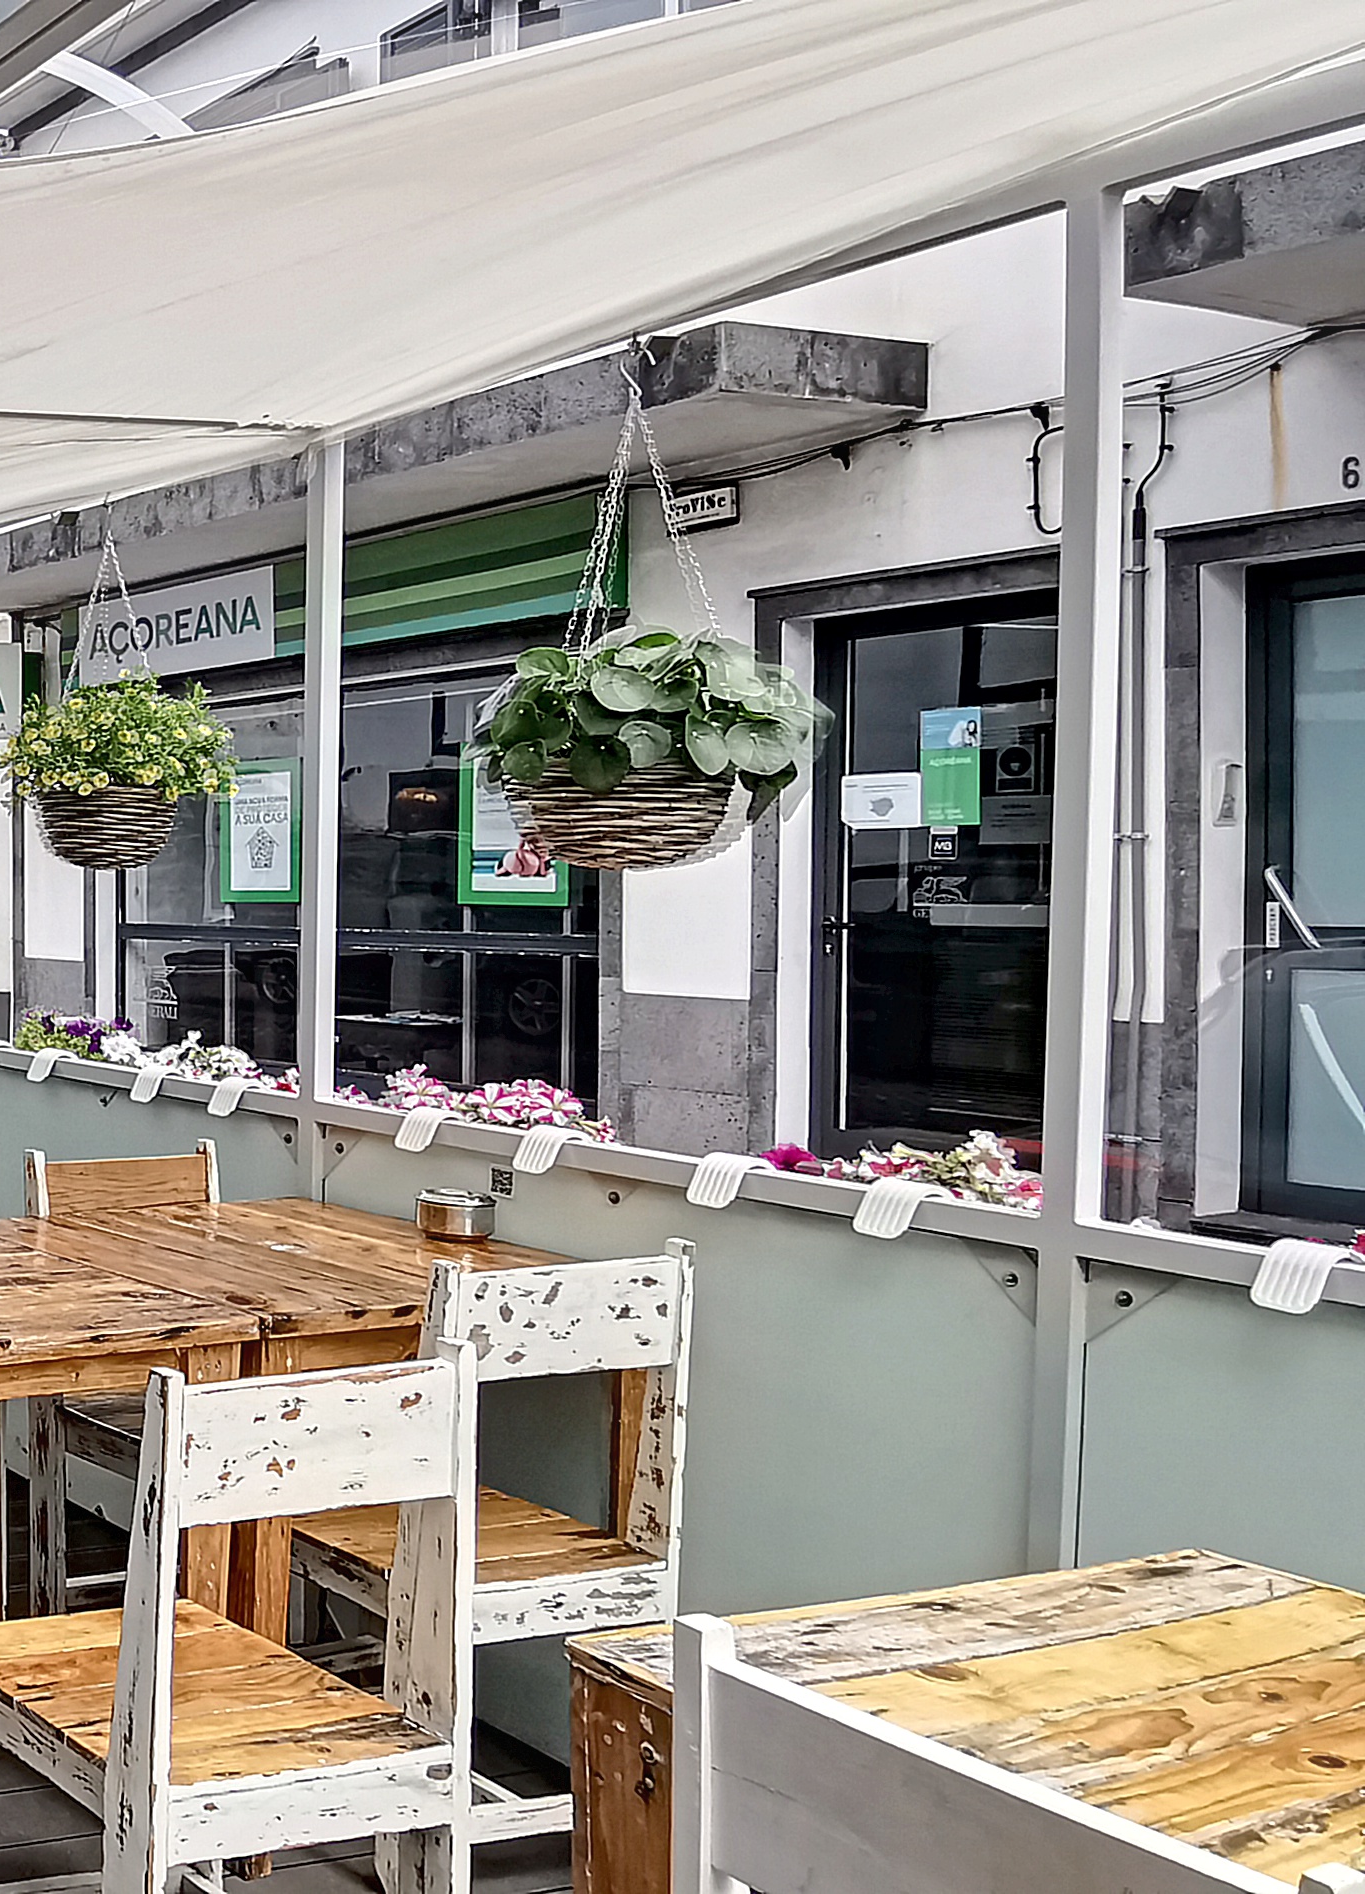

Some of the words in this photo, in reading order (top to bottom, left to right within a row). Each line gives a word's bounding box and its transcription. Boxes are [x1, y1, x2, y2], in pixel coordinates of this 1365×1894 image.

[1342, 456, 1360, 490] 6
[89, 596, 261, 664] AÇOREANA
[263, 812, 288, 824] CASA
